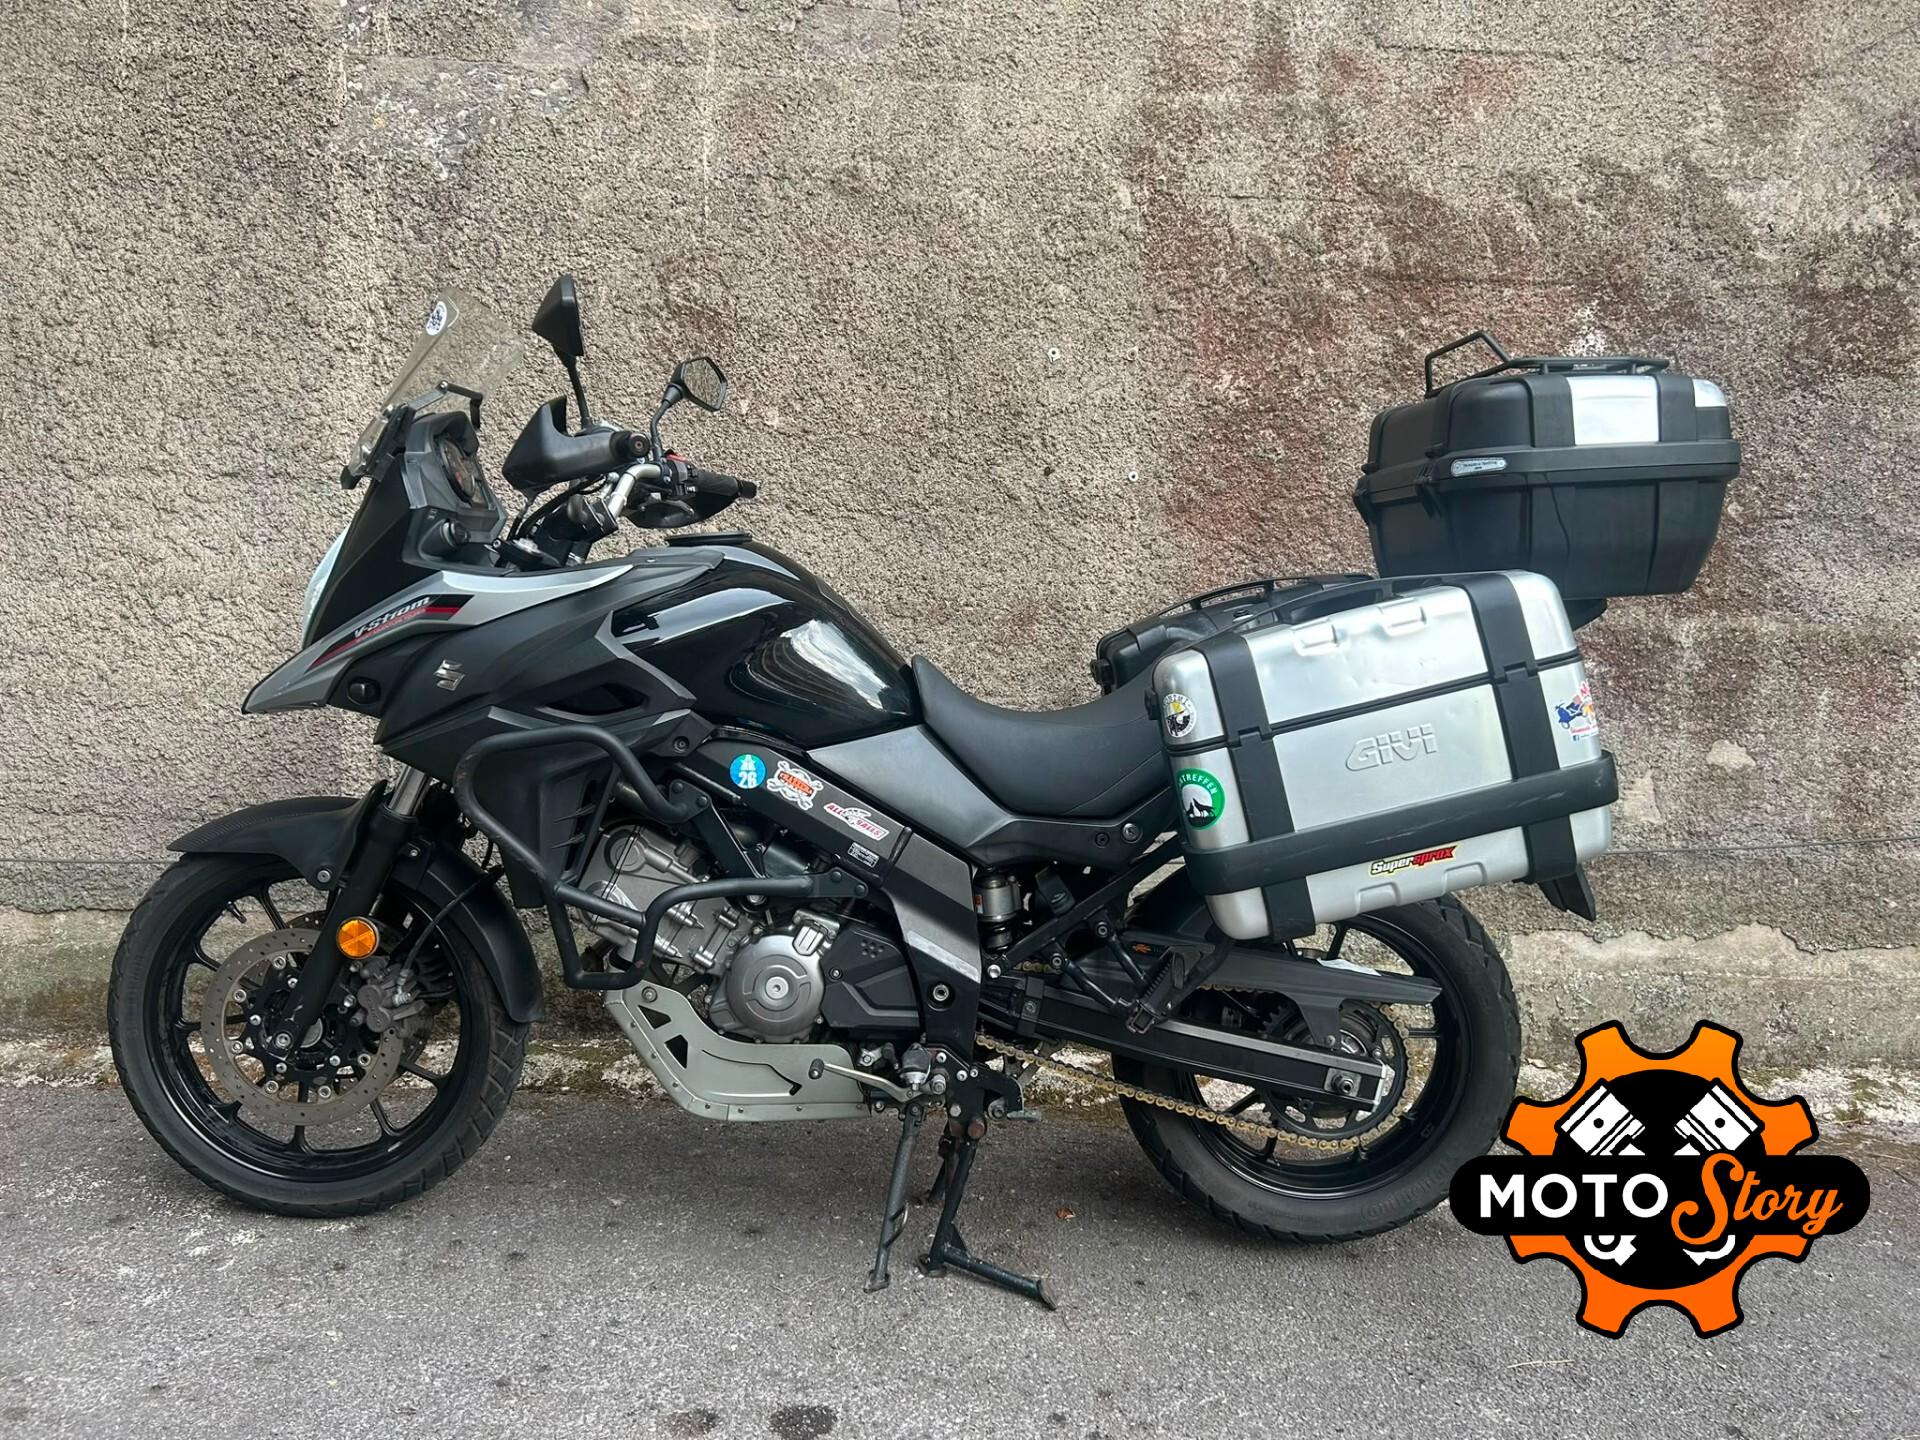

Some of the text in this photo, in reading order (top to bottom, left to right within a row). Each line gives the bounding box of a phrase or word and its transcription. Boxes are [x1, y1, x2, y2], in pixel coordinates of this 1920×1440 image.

[1345, 722, 1438, 772] GIVI
[738, 771, 758, 789] 26
[1370, 844, 1458, 875] Supersprox
